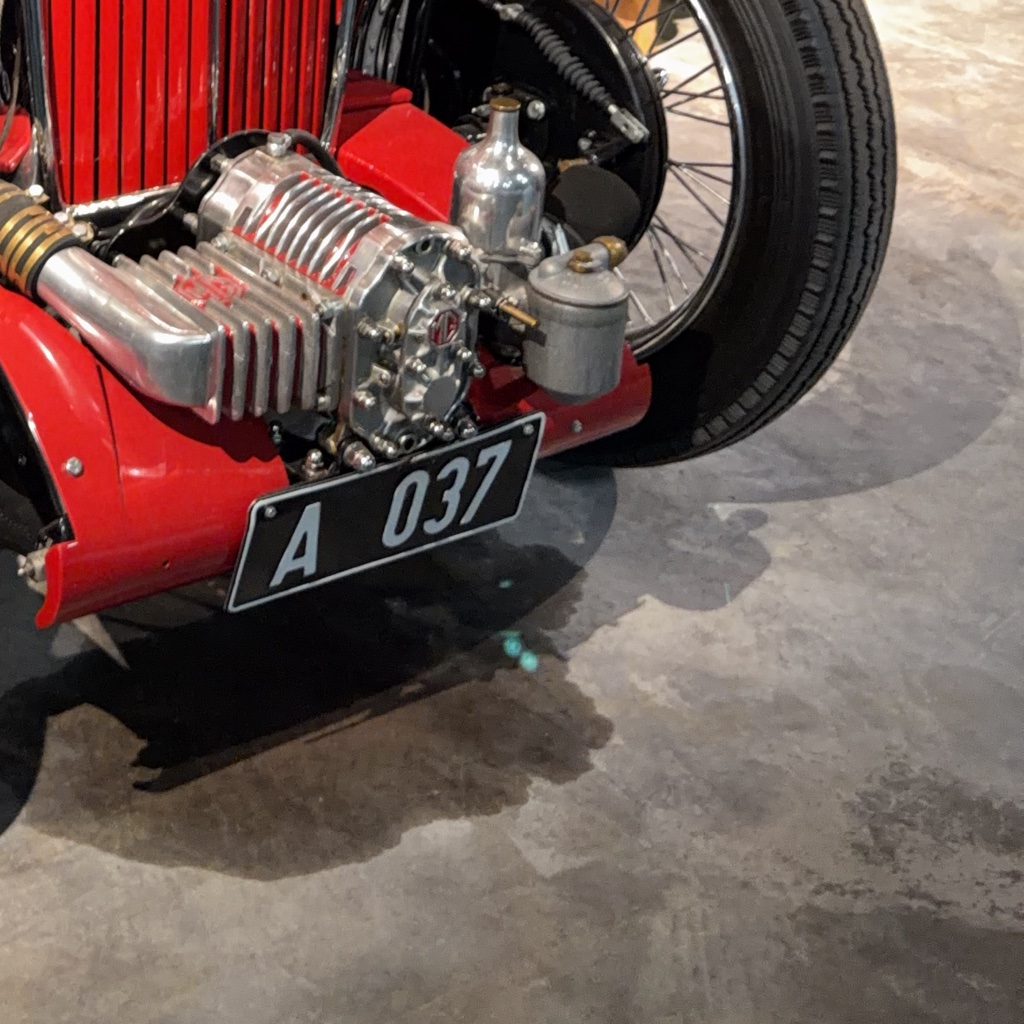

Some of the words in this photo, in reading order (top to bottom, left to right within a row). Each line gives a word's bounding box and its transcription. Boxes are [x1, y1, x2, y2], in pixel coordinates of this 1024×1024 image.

[431, 311, 458, 345] MG
[269, 502, 321, 587] A
[382, 440, 512, 548] 037
